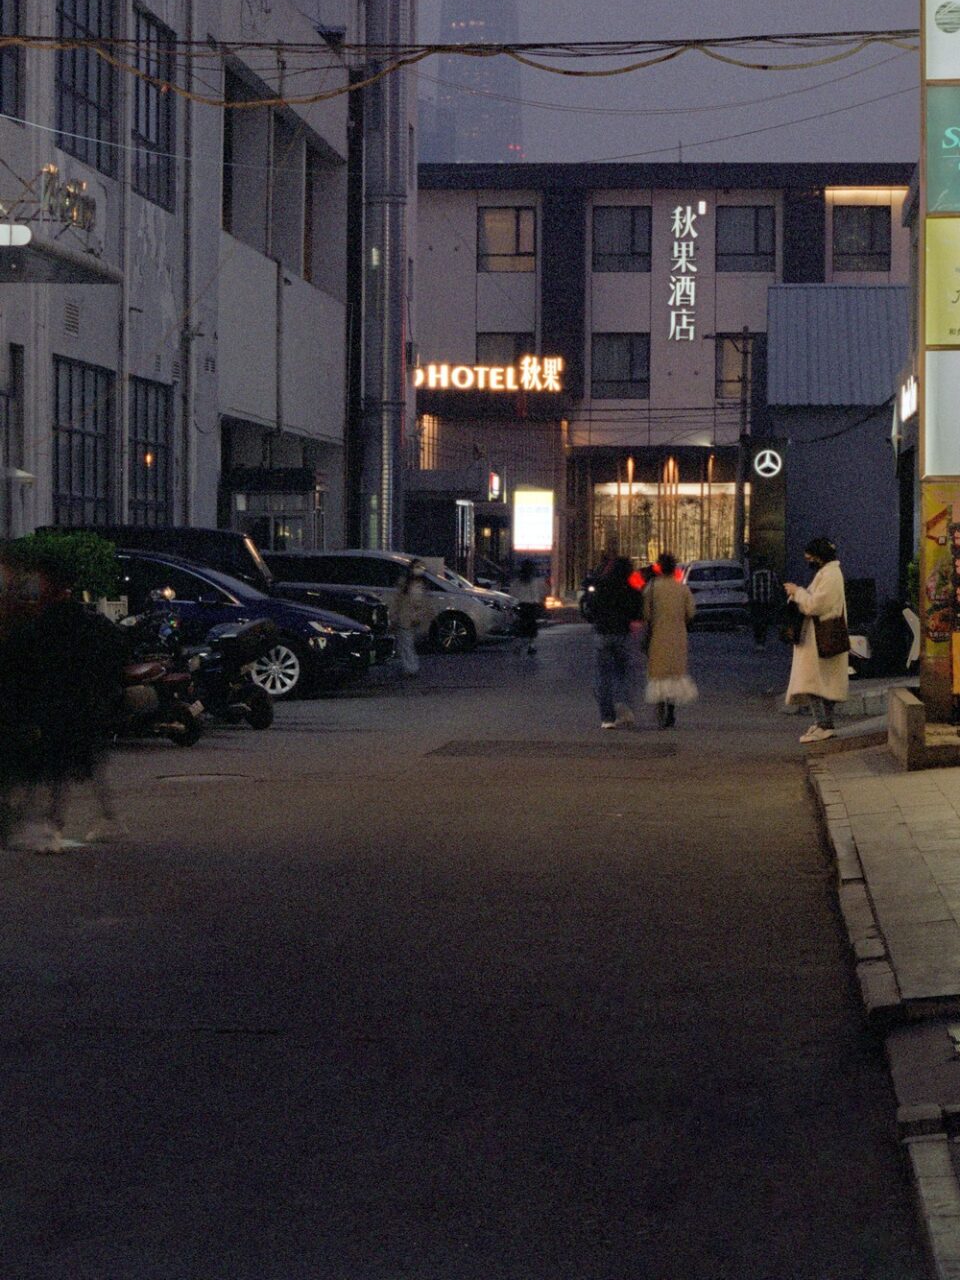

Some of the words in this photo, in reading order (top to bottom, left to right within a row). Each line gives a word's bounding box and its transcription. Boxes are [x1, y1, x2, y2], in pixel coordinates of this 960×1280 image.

[667, 205, 699, 341] 秋果酒店
[428, 364, 518, 390] HOTEL
[520, 355, 563, 392] 秋果
